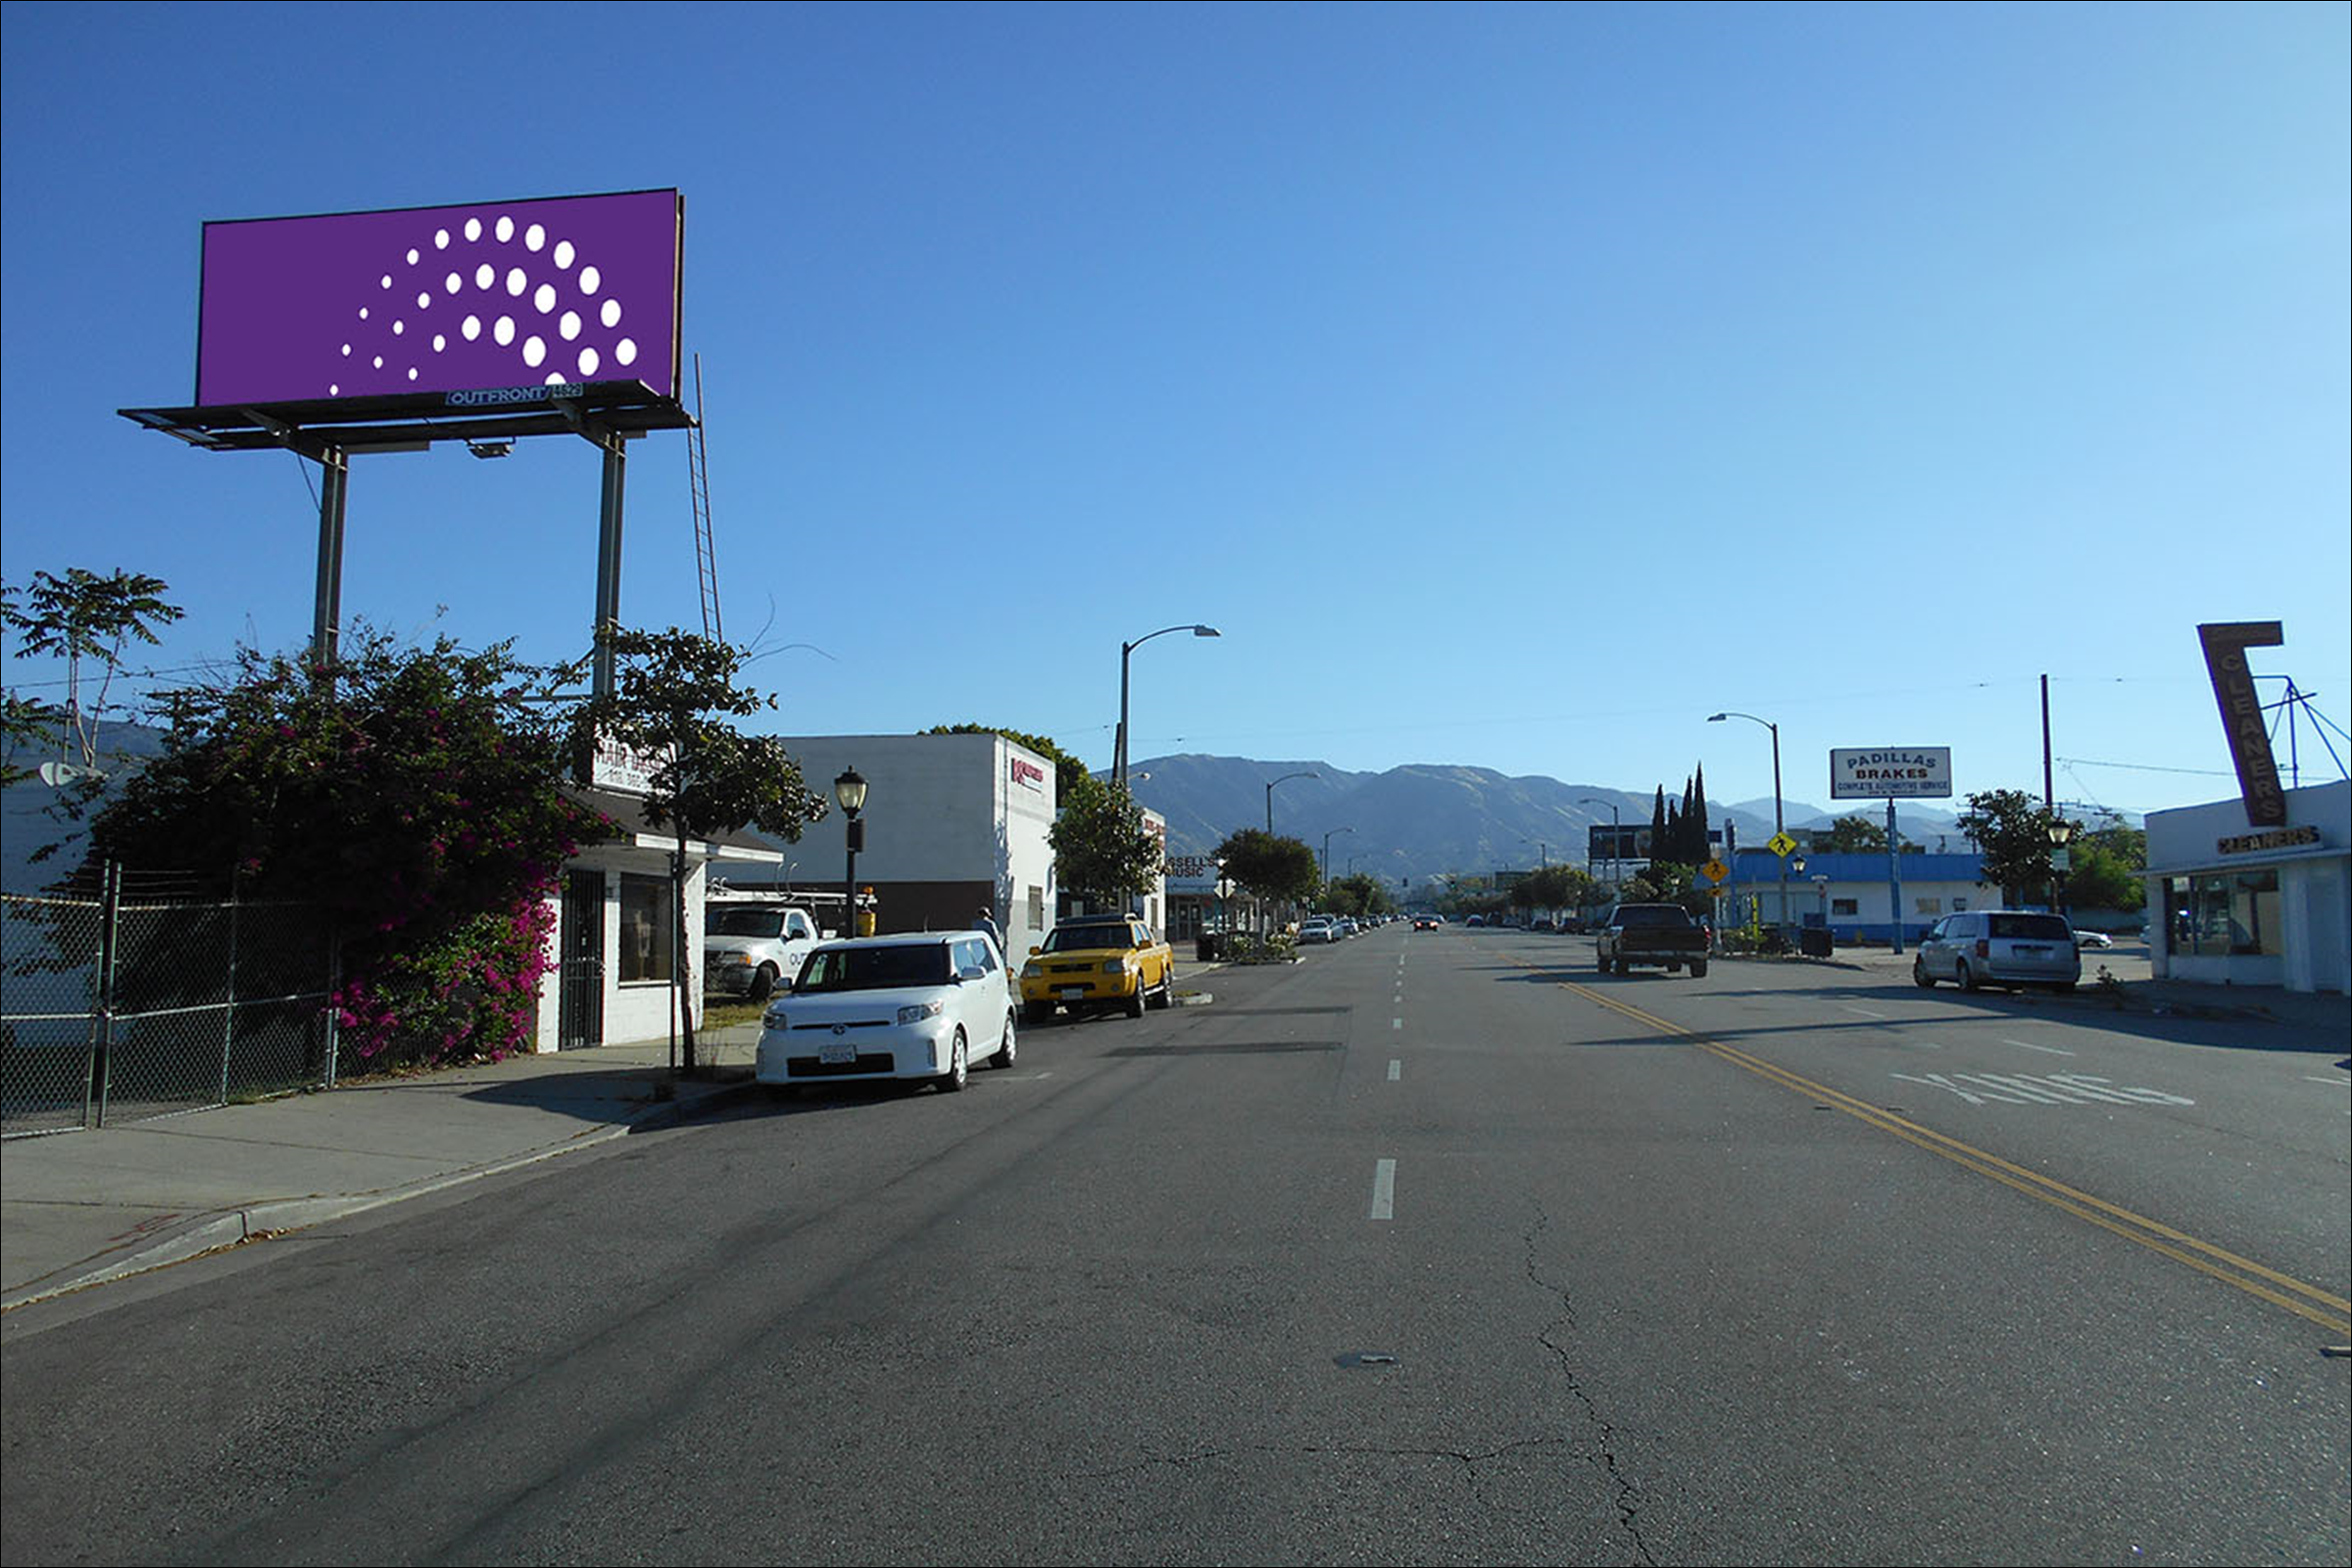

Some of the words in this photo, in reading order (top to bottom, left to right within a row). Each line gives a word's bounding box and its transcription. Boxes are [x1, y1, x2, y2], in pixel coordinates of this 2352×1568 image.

[451, 386, 546, 404] OUTFRONT
[2222, 655, 2280, 818] CLEANERS
[1847, 753, 1936, 768] PADILLAS
[1856, 768, 1928, 779] BRAKES
